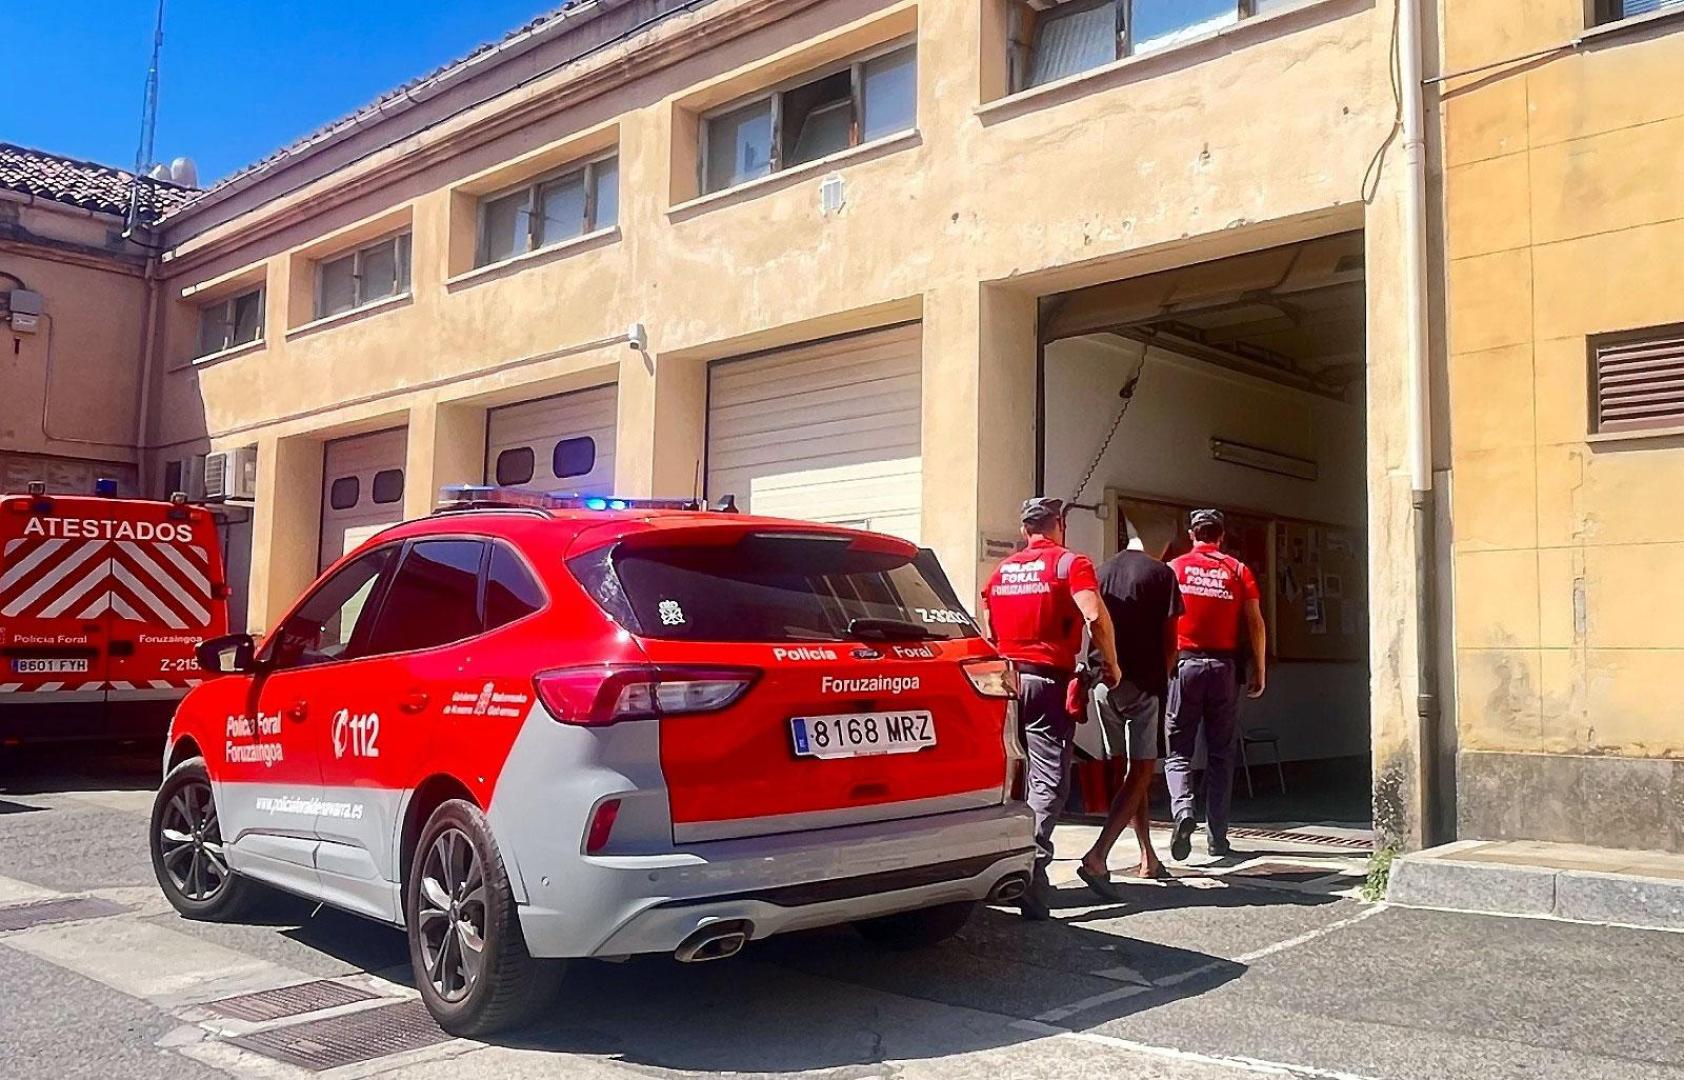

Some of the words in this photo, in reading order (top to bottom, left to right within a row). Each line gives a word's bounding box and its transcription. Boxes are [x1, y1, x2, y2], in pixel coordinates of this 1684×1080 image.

[24, 517, 192, 542] ATESTADOS
[1001, 571, 1041, 584] FORAL
[1187, 575, 1226, 589] FORAL
[57, 634, 87, 644] Foral
[892, 645, 934, 659] Foral
[20, 660, 53, 671] 8601
[60, 660, 86, 671] FYH
[160, 658, 202, 672] Z-215
[821, 674, 920, 694] Foruzaingoa
[257, 710, 282, 735] Foral
[349, 712, 380, 757] 112
[814, 718, 879, 747] 8168
[885, 715, 932, 742] MRZ
